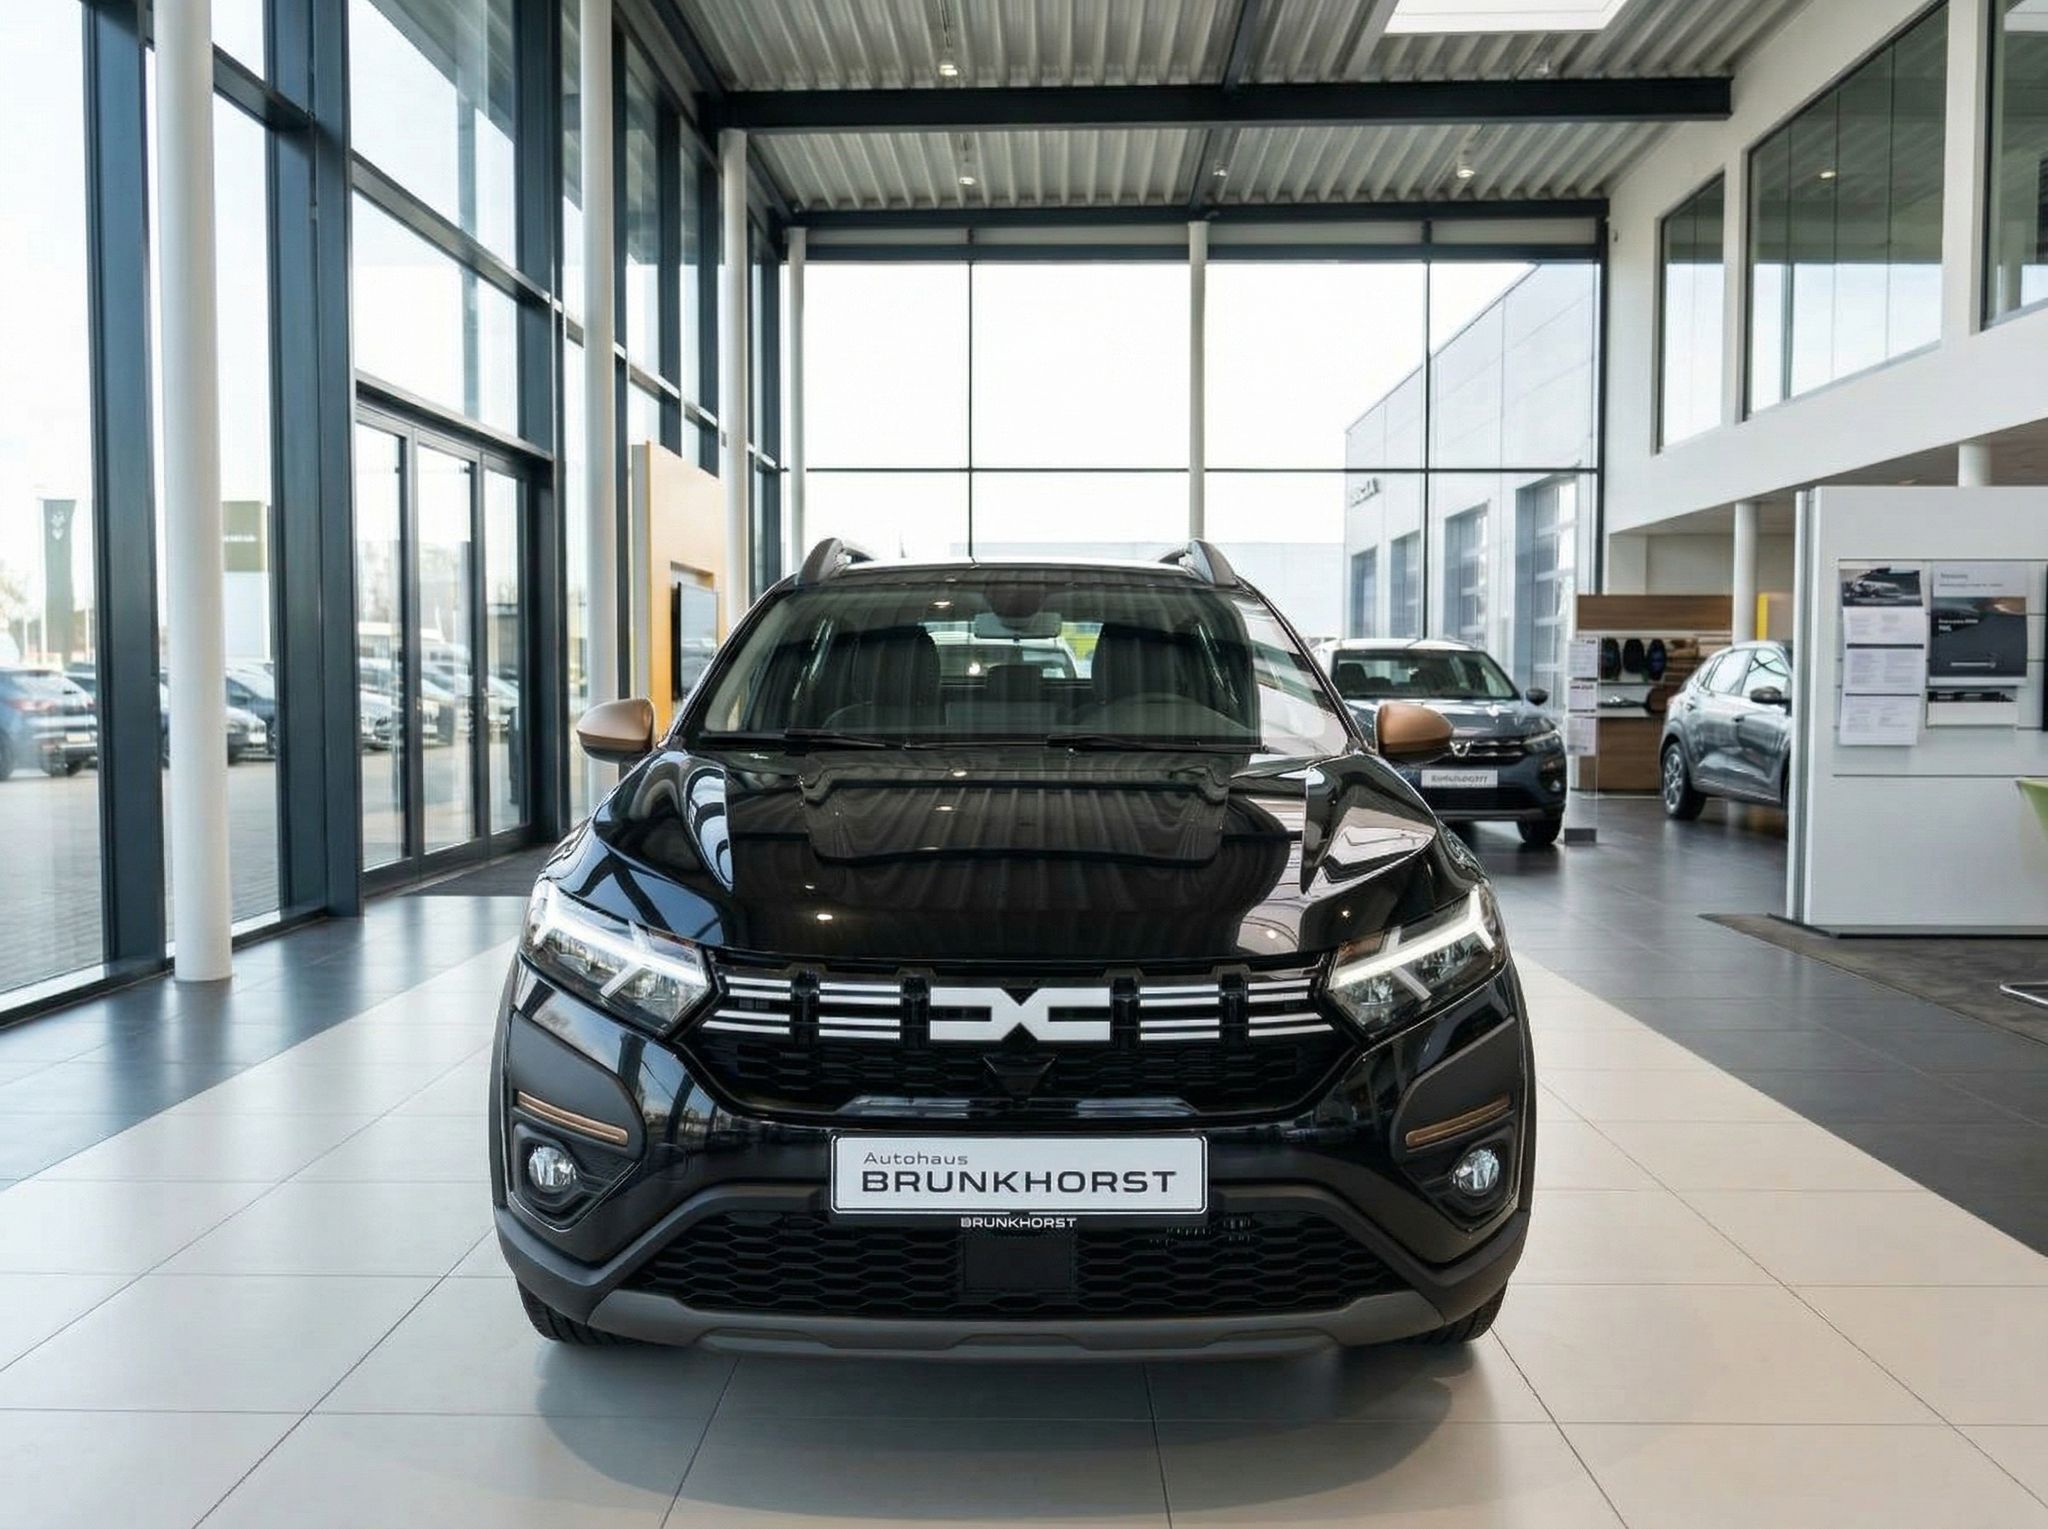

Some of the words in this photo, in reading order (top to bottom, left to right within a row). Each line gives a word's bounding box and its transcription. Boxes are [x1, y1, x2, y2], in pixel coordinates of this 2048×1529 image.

[863, 1151, 969, 1166] Autohaus
[861, 1170, 1178, 1194] BRUNKHORST
[960, 1216, 1078, 1229] BRUNKHORST
